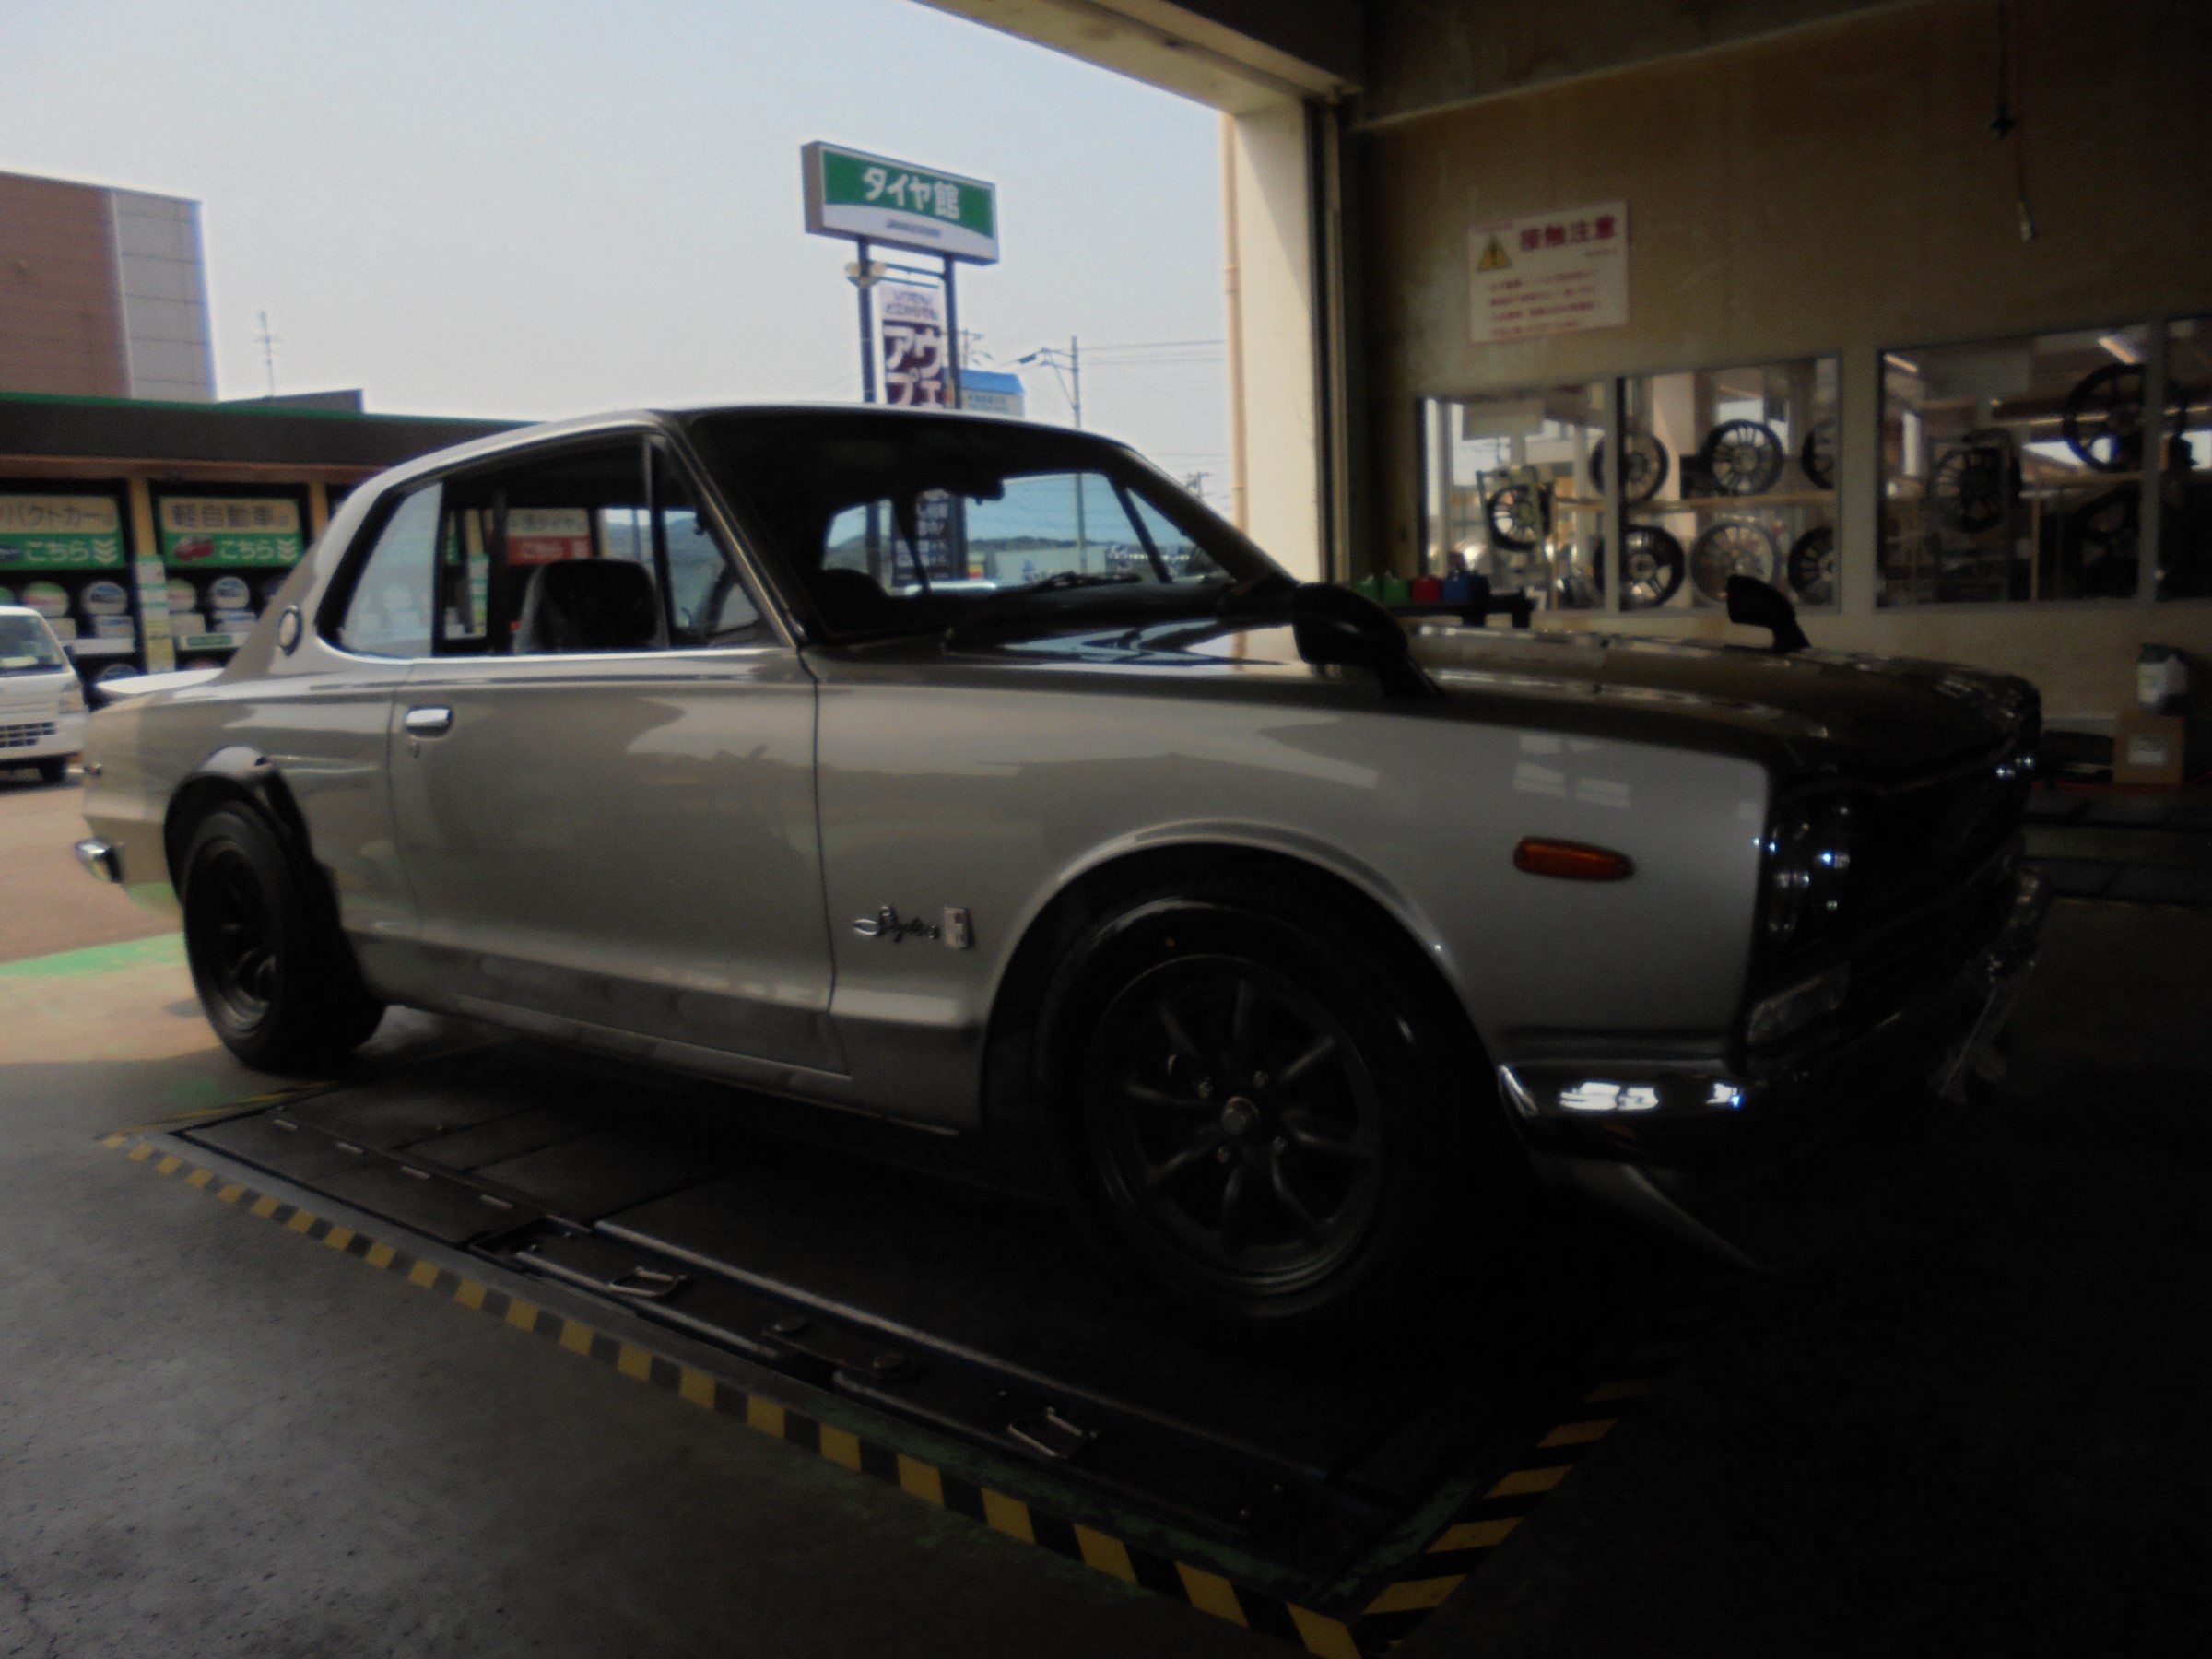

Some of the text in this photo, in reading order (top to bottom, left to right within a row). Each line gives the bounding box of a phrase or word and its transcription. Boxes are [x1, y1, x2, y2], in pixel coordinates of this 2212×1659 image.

[864, 167, 959, 219] タイヤ館
[25, 540, 89, 562] こちら
[219, 539, 274, 560] こちら
